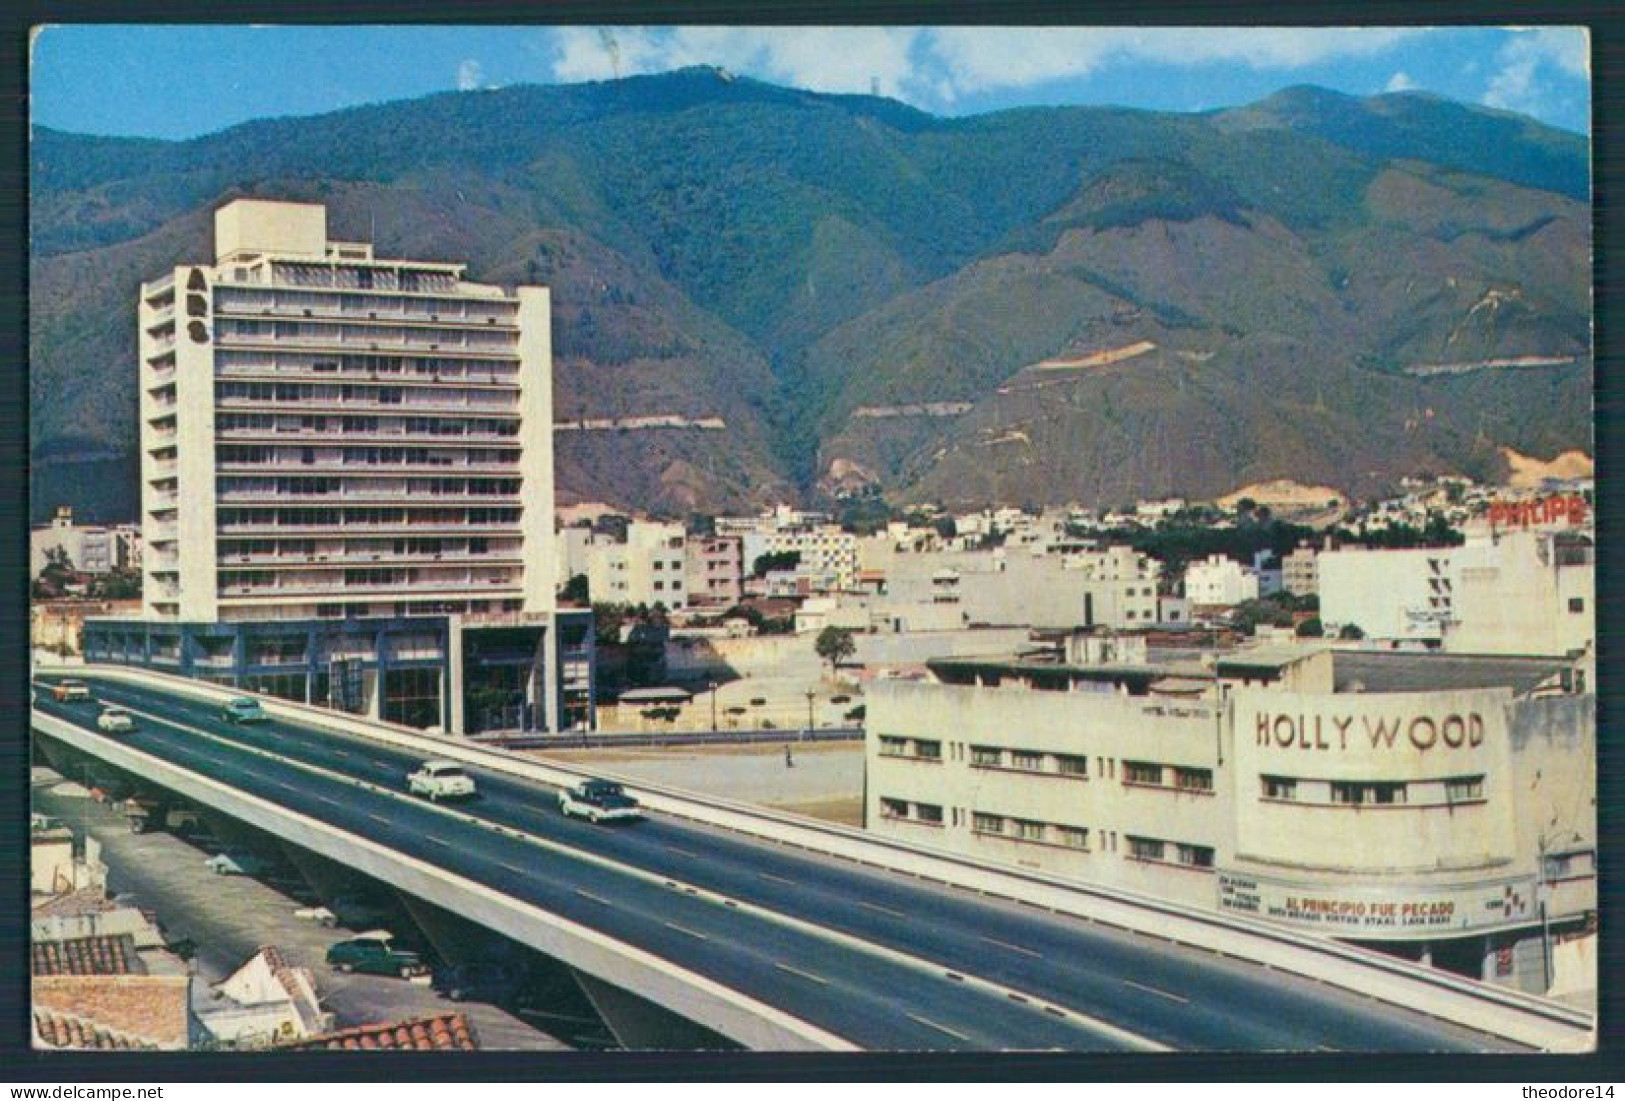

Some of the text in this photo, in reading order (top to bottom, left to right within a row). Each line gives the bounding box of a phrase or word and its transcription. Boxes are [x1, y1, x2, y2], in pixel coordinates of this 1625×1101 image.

[1256, 711, 1484, 751] HOLLYWOOD
[1286, 897, 1299, 910] EL
[1302, 897, 1366, 917] PRINCIPIO
[1371, 902, 1396, 917] FUE
[1402, 901, 1454, 916] PECADO
